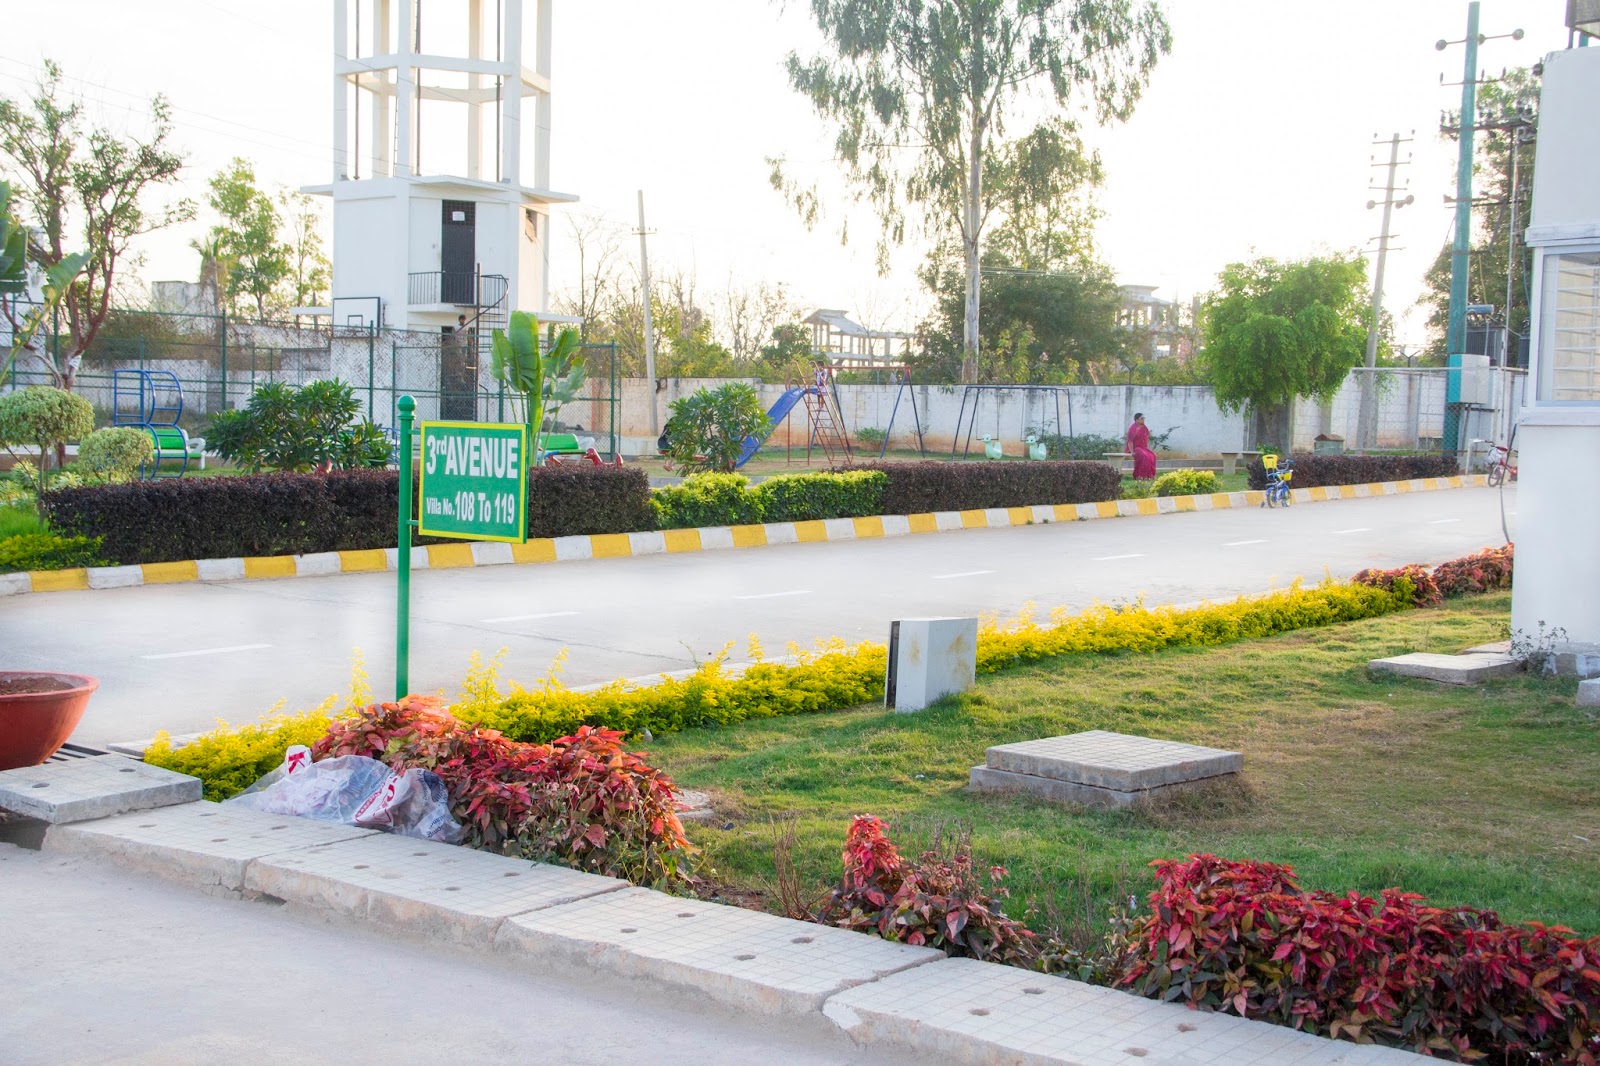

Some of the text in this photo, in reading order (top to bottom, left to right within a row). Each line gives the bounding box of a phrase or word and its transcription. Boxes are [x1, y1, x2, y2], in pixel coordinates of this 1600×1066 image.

[426, 435, 518, 479] 3rd AVENUE
[426, 491, 515, 524] Villa No. 108 To 119
